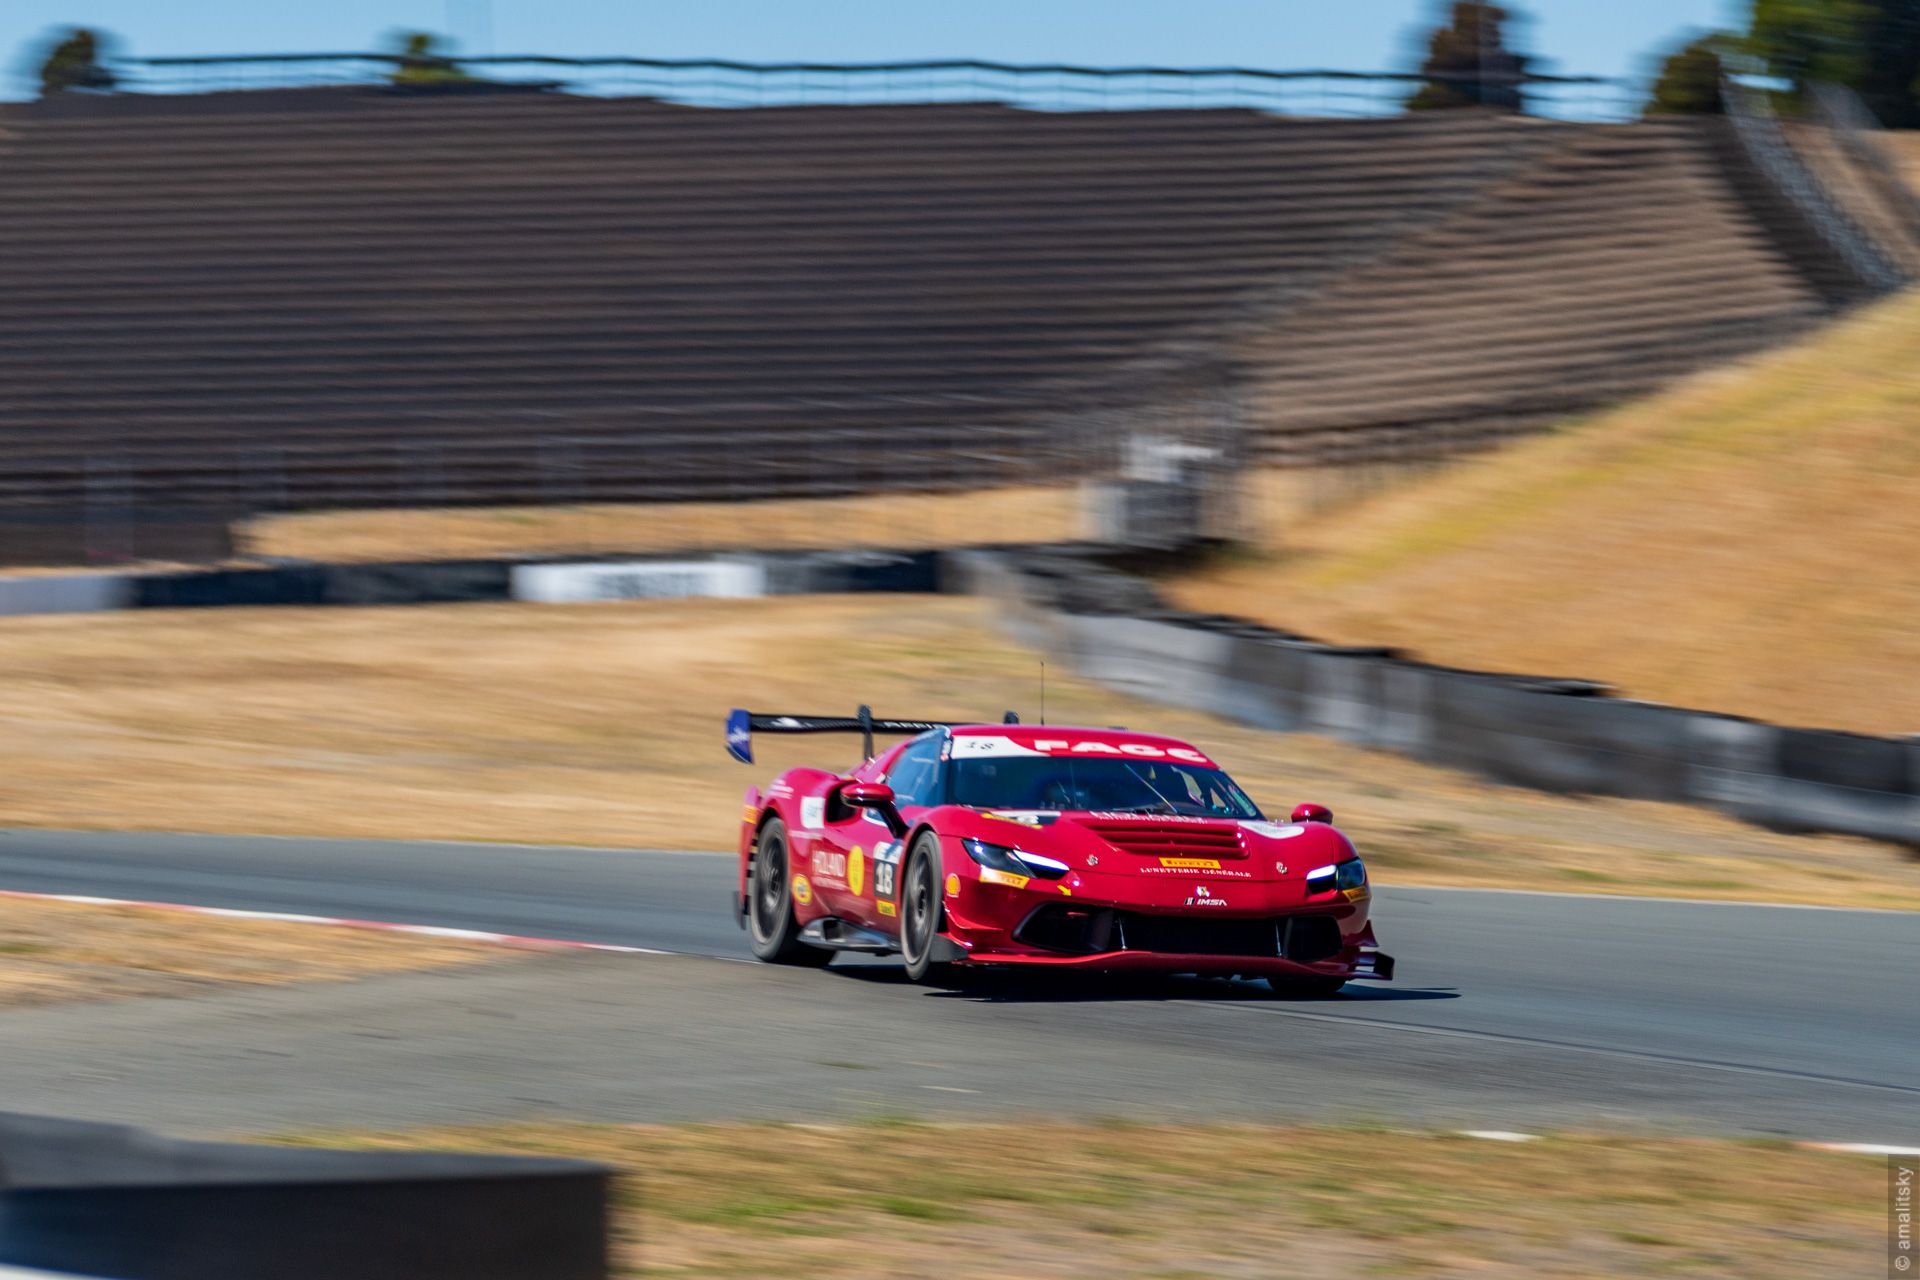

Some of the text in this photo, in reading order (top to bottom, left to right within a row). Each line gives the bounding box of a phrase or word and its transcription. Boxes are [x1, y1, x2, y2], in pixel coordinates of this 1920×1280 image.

[1166, 859, 1215, 868] PIRELLI
[1139, 867, 1252, 878] LUNETTERIE GÉNÉRALE
[875, 862, 893, 895] 18
[1197, 898, 1228, 907] IMSA
